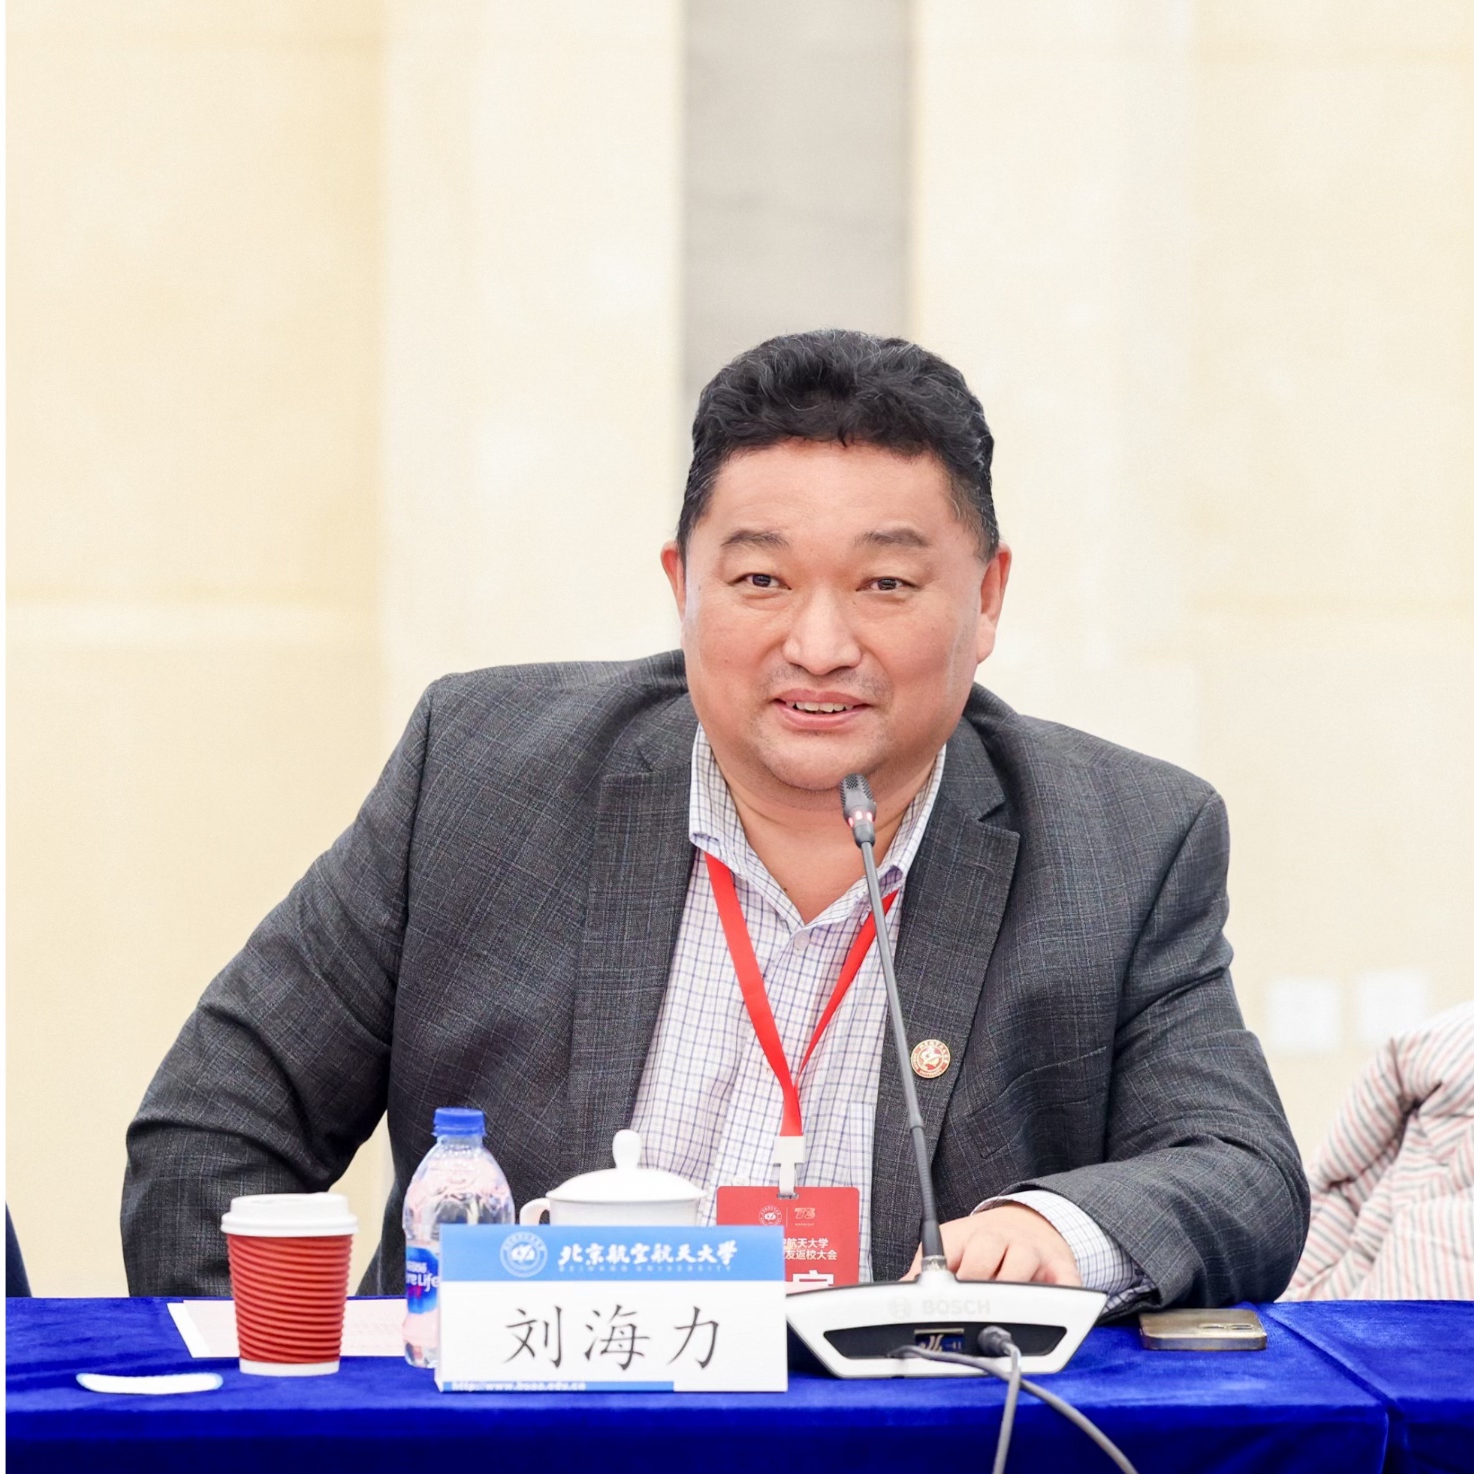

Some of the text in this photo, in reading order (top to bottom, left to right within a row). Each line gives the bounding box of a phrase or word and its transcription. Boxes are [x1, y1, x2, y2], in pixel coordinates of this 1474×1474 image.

[783, 1237, 829, 1249] 航天大学
[557, 1240, 738, 1266] 北京航空航天大学
[783, 1249, 838, 1261] 友返校大会
[922, 1299, 991, 1316] BOSCH
[502, 1304, 719, 1371] 刘海力
